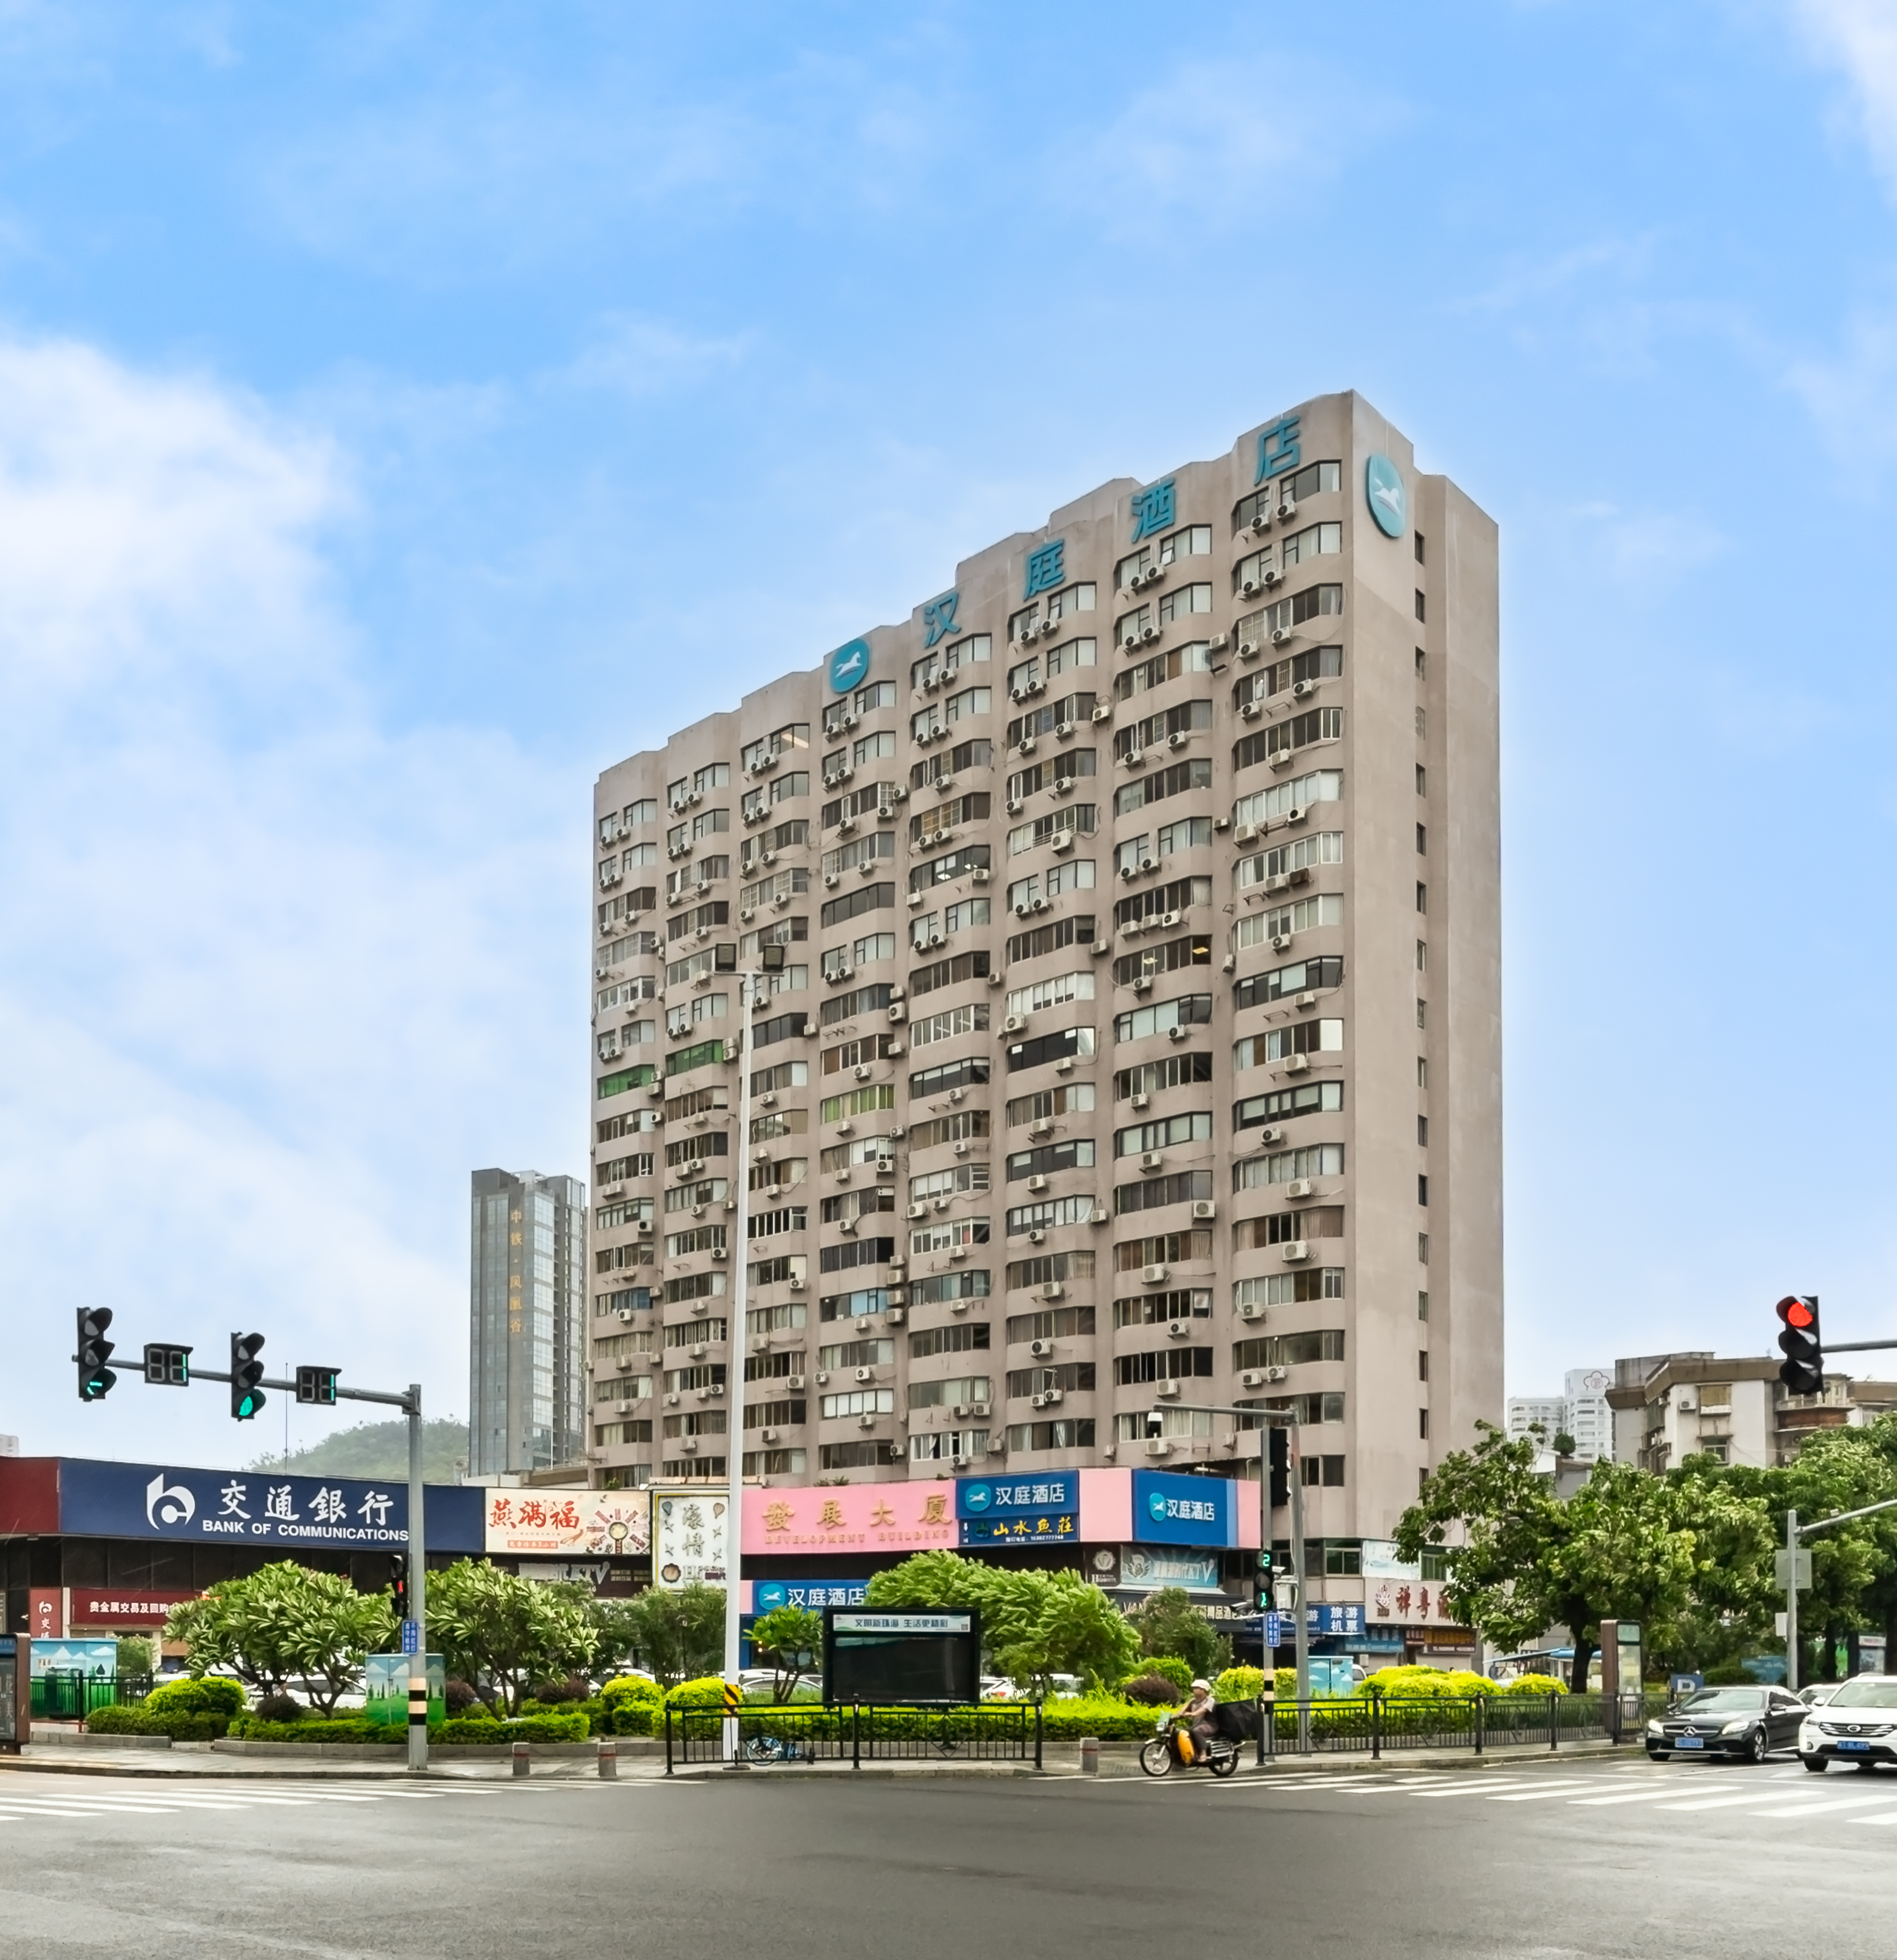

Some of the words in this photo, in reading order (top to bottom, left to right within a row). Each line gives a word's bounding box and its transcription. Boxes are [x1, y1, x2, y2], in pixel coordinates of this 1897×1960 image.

[923, 416, 1301, 649] 汉庭酒店
[996, 1483, 1065, 1505] 汉庭酒店
[1166, 1499, 1215, 1521] 汉庭酒店
[202, 1520, 245, 1533] BANK
[251, 1523, 271, 1534] OF
[278, 1524, 409, 1541] COMMUNICATIONS
[765, 1534, 865, 1544] DEVELOPMENT
[878, 1529, 949, 1542] BUILDING
[1263, 1554, 1270, 1567] 2
[788, 1588, 865, 1606] 汉庭酒店
[1330, 1606, 1358, 1619] 旅游
[1330, 1620, 1358, 1632] 机票
